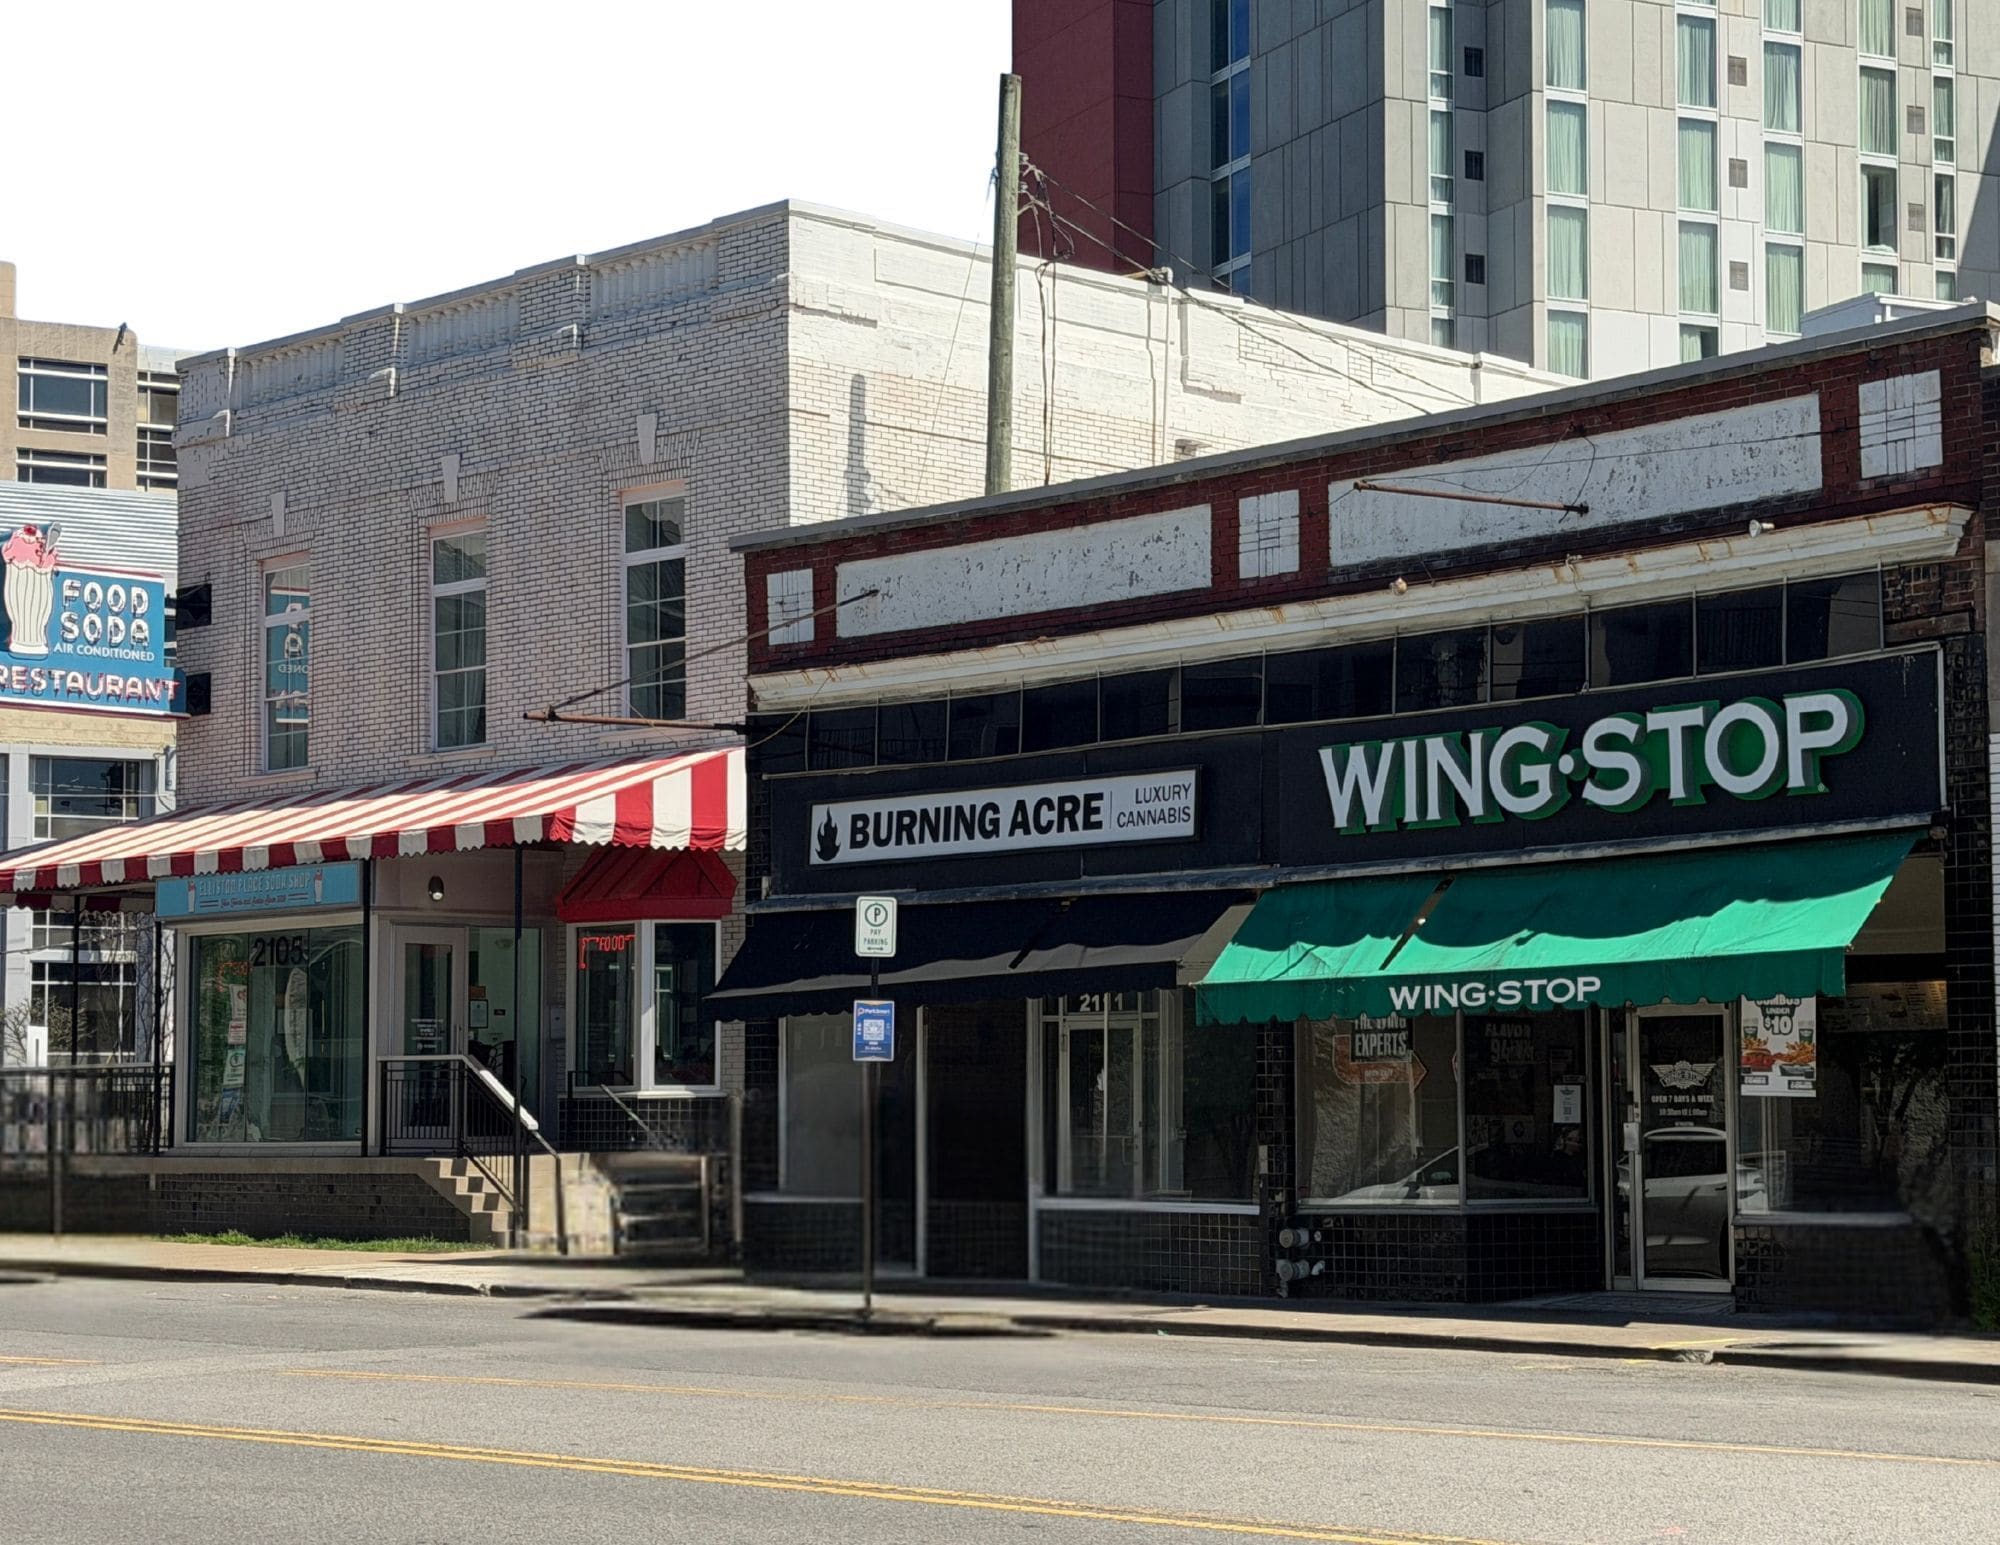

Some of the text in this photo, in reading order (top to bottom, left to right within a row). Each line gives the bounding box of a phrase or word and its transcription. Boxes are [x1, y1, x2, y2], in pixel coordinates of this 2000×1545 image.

[62, 578, 149, 616] FOOD
[60, 611, 149, 647] SODA
[54, 643, 155, 662] AIR CONDITIONED
[1135, 783, 1192, 805] LUXURY
[849, 792, 1104, 849] BURNING ACRE
[1116, 805, 1192, 829] CANNABIS
[288, 870, 311, 887] SHOP
[253, 936, 304, 967] 2105
[599, 934, 624, 951] FOOD
[863, 937, 888, 945] PARKING
[1080, 992, 1123, 1012] 211
[1764, 1015, 1793, 1035] $10
[1354, 1031, 1408, 1057] EXPERTS
